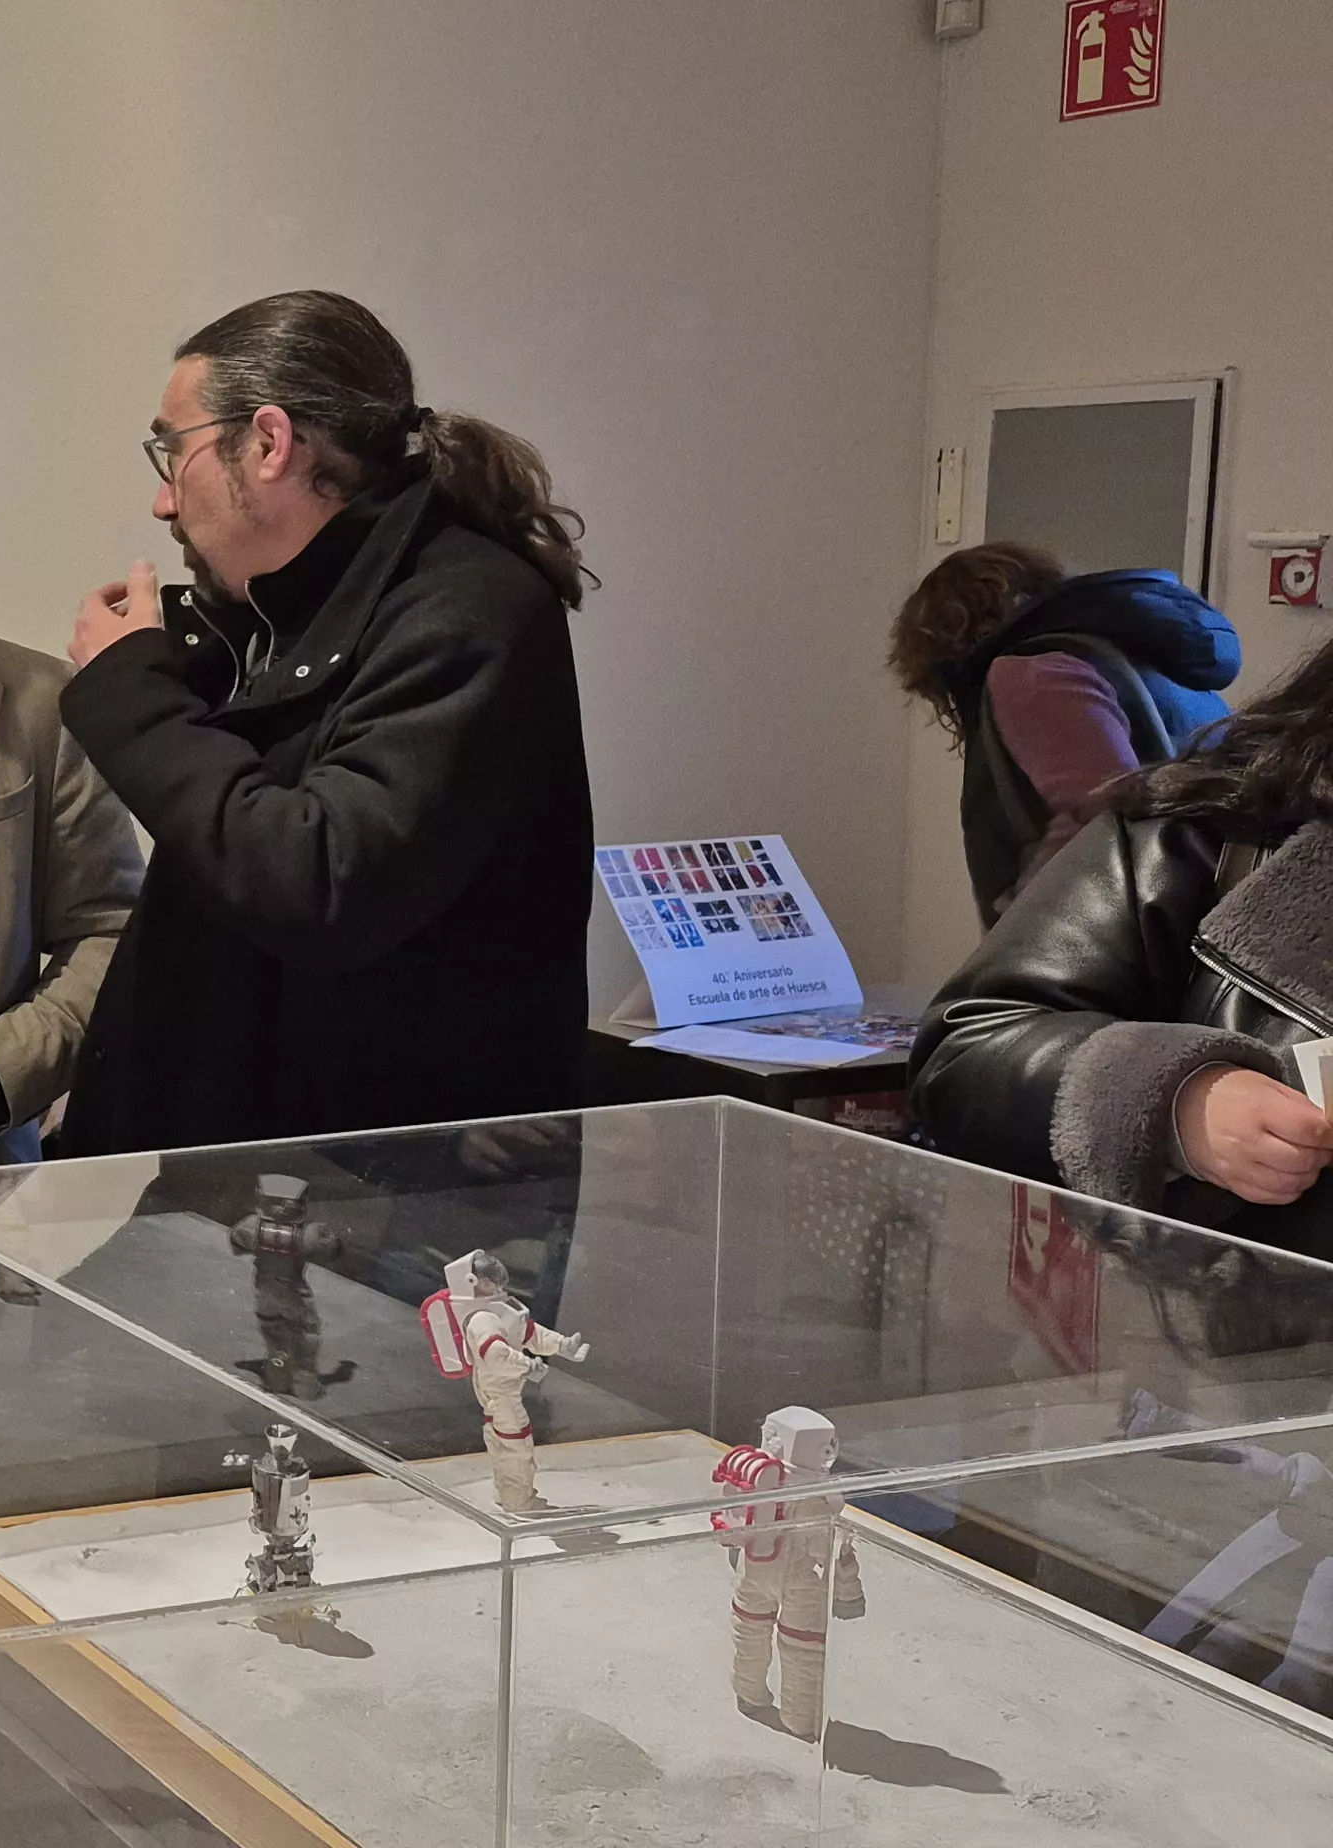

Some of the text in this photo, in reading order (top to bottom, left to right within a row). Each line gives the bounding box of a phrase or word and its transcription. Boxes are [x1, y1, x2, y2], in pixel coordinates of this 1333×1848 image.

[734, 964, 794, 983] Aniversario
[688, 990, 731, 1006] Escuela
[733, 988, 747, 1001] de
[749, 986, 770, 999] arte
[772, 984, 785, 996] de
[787, 980, 827, 996] Huesca
